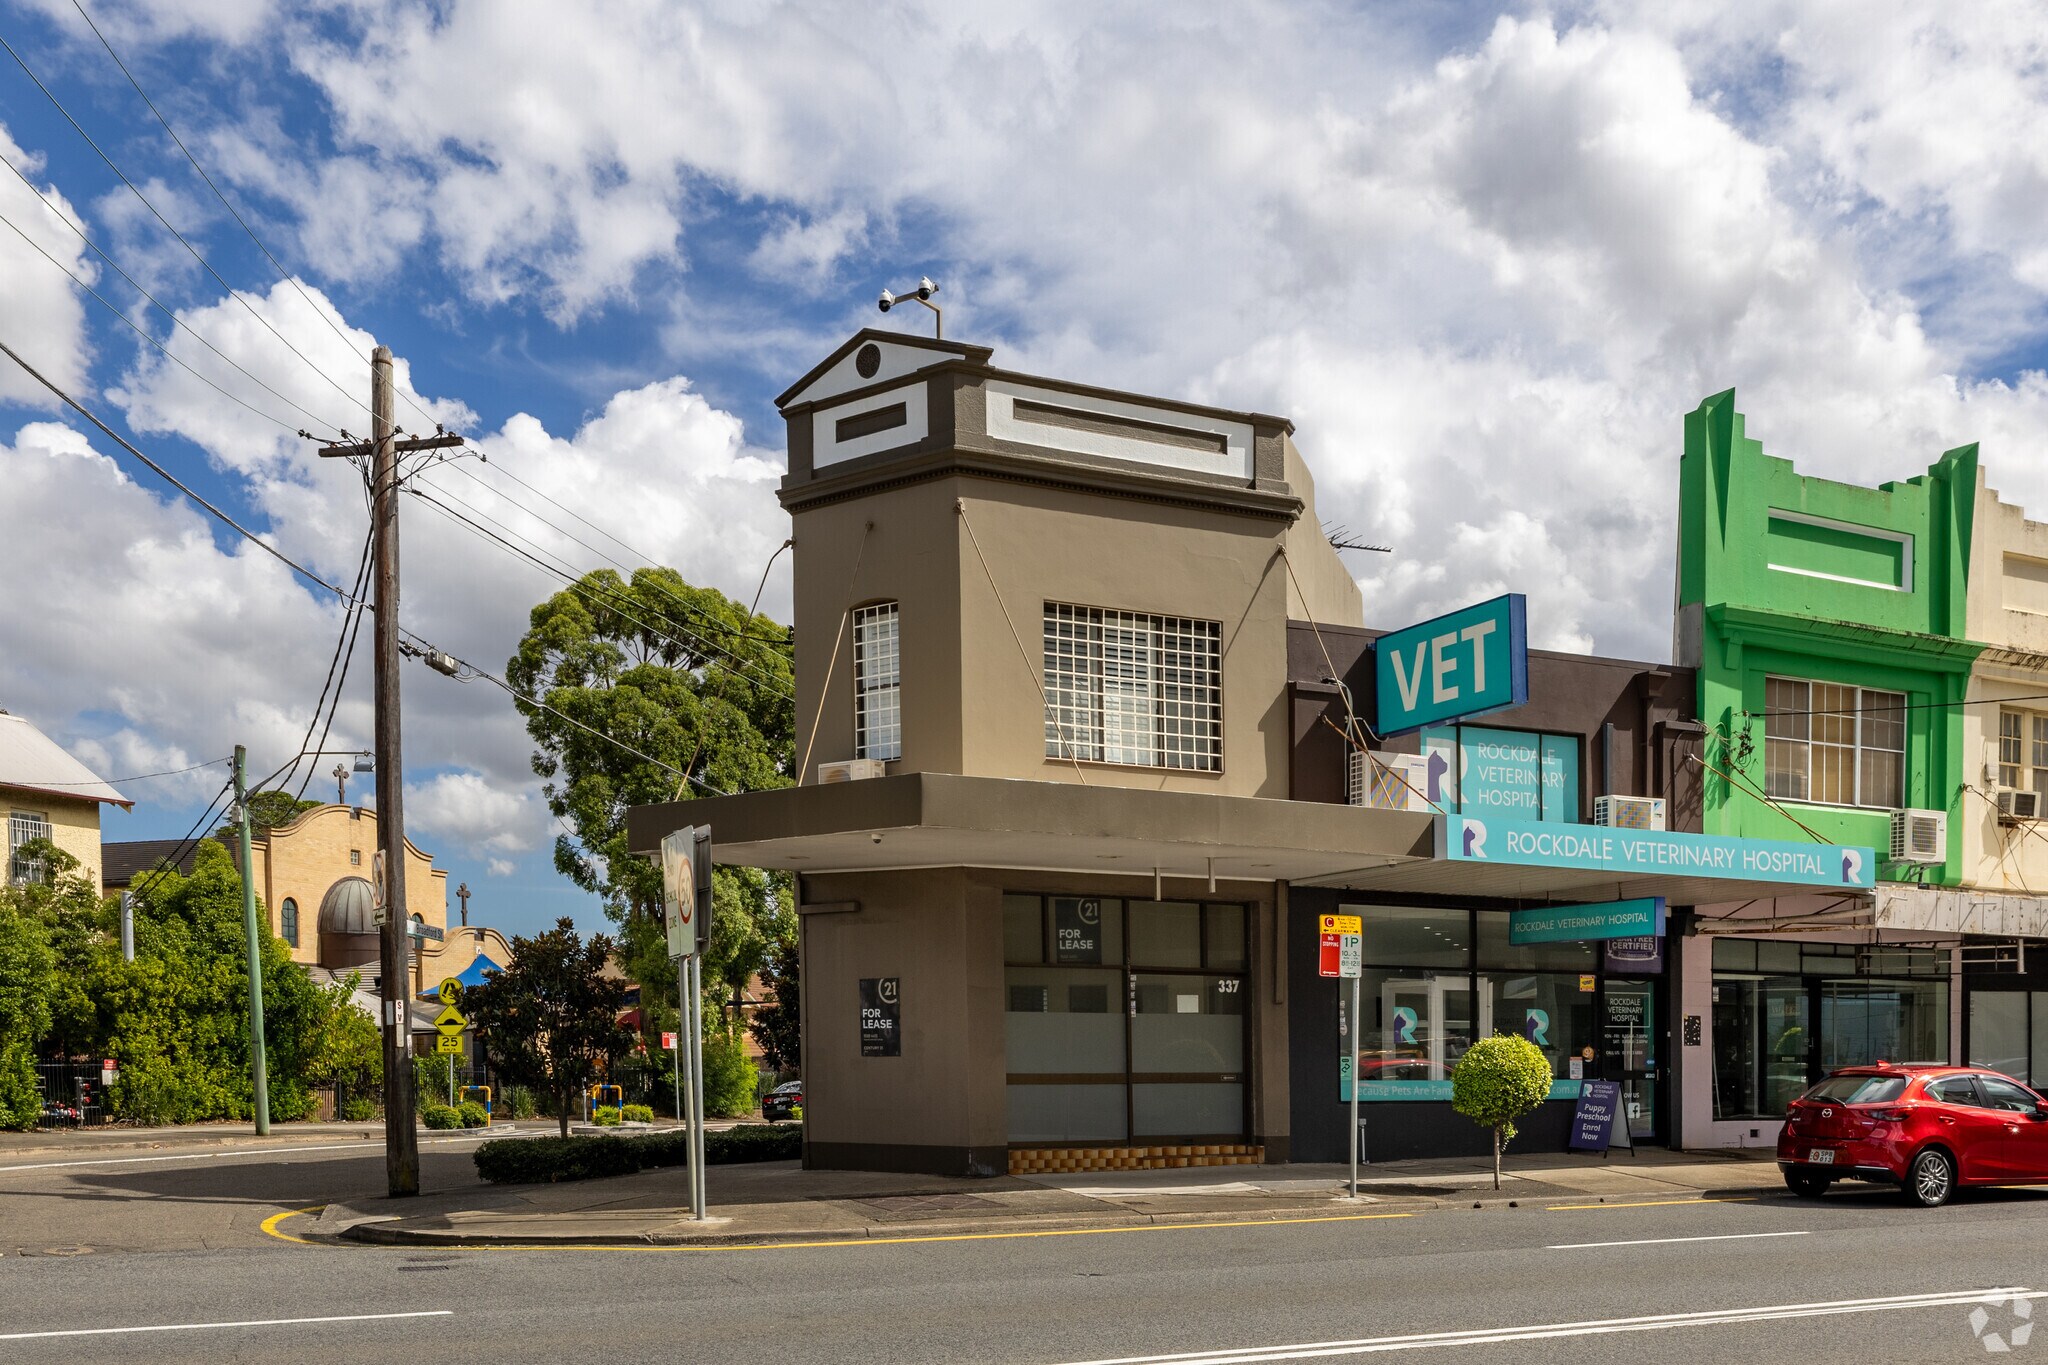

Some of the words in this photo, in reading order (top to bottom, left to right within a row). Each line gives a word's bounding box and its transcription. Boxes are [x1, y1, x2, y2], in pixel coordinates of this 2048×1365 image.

[1390, 619, 1496, 712] VET
[1478, 743, 1556, 765] ROCKDALE
[1478, 766, 1567, 788] VETERINARY
[1479, 789, 1549, 810] HOSPITAL
[1507, 831, 1613, 860] ROCKDALE
[1621, 839, 1736, 869] VETERINARY
[1743, 850, 1825, 875] HOSPITAL
[1515, 920, 1555, 933] ROCKDALE
[1558, 915, 1606, 929] VETERINARY
[1608, 912, 1649, 925] HOSPITAL
[1059, 929, 1081, 939] FOR
[1059, 940, 1094, 950] LEASE
[1344, 936, 1359, 948] 1P
[1612, 942, 1653, 950] CERTIFIED
[1218, 980, 1240, 993] 337
[1610, 998, 1641, 1006] ROCKDALE
[862, 1008, 881, 1018] FOR
[1607, 1006, 1644, 1014] VETERINARY
[1611, 1014, 1640, 1022] HOSPITAL
[862, 1019, 893, 1029] LEASE
[442, 1036, 459, 1047] 25
[1391, 1085, 1412, 1096] Pets
[1413, 1085, 1430, 1096] Are
[1584, 1103, 1607, 1114] Puppy
[1577, 1111, 1611, 1122] Preschool
[1582, 1122, 1601, 1132] Enrol
[1581, 1132, 1598, 1140] Now
